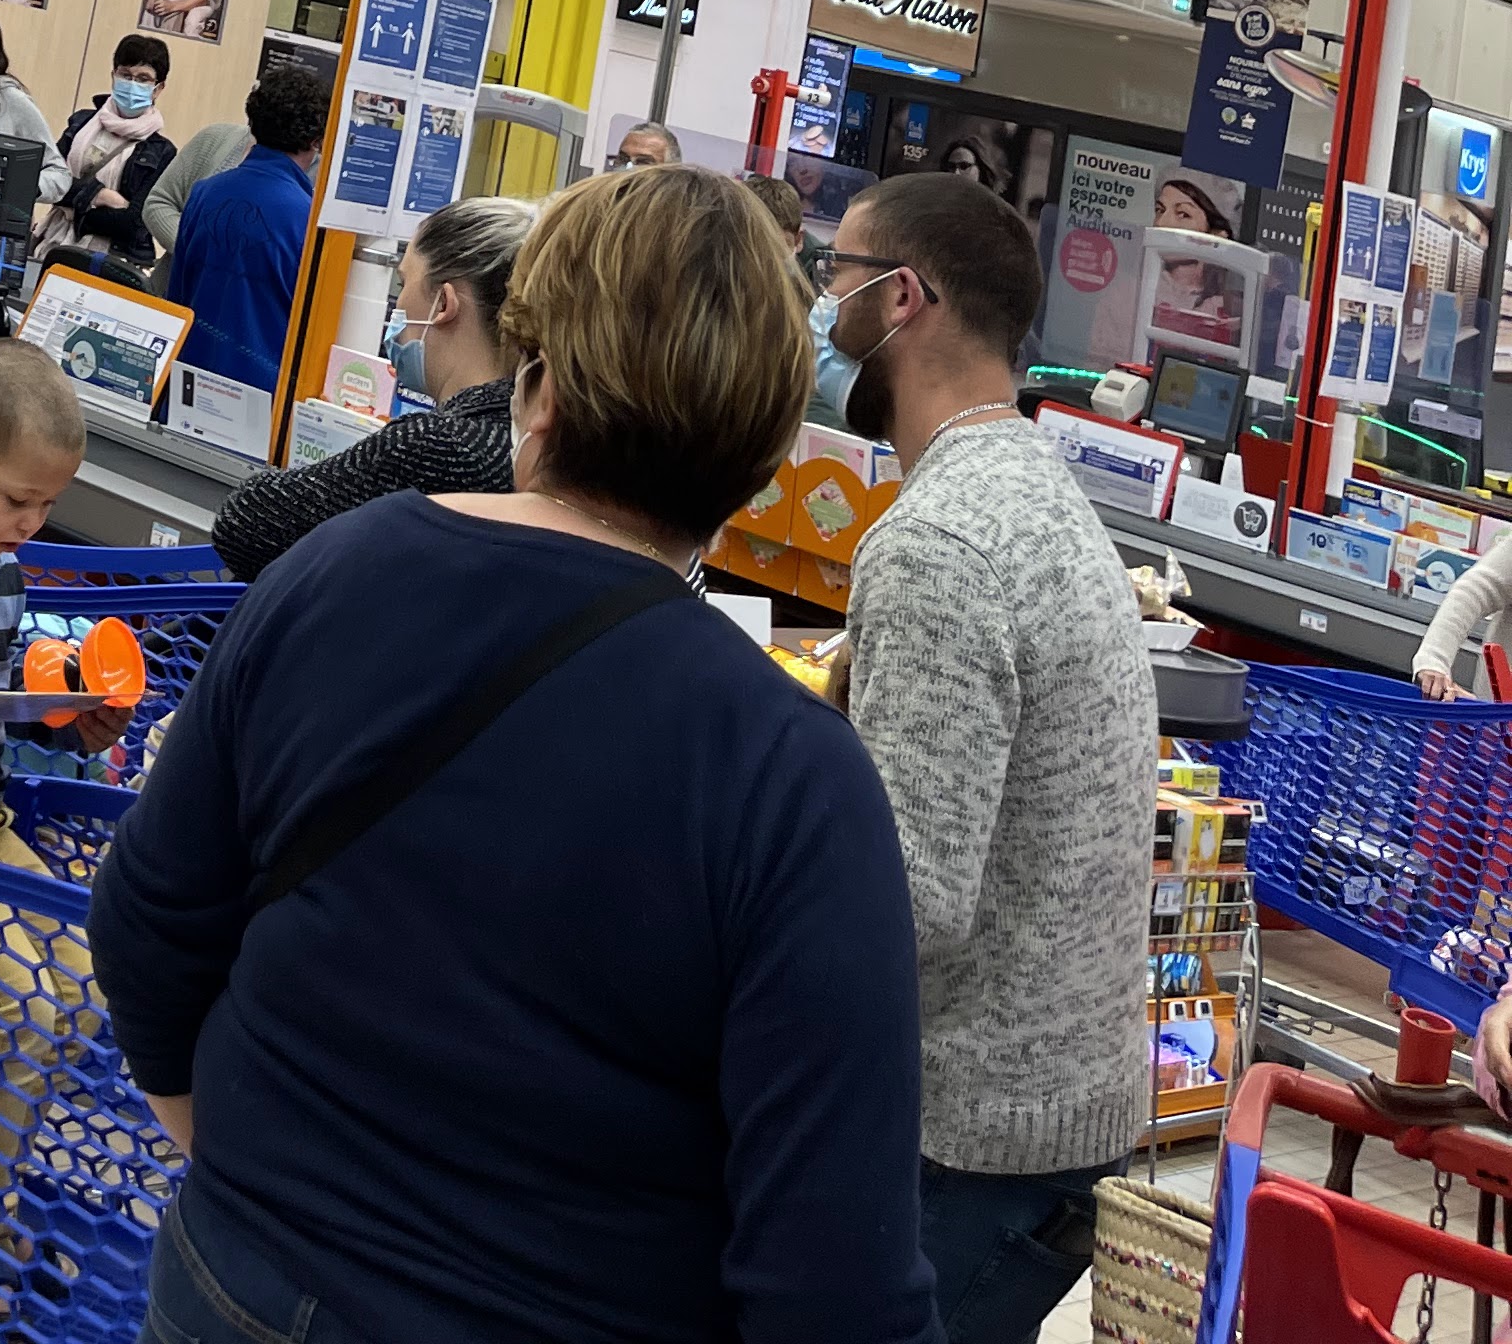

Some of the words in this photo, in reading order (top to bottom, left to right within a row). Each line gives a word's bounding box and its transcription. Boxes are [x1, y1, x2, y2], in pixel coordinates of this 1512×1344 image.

[807, 93, 820, 103] 13
[1076, 153, 1151, 179] nouveau
[1460, 148, 1485, 178] Krys
[1072, 171, 1090, 187] ici
[1095, 178, 1135, 197] votre
[1069, 199, 1104, 220] Krys
[1070, 187, 1127, 209] espace
[1066, 214, 1133, 240] Audition
